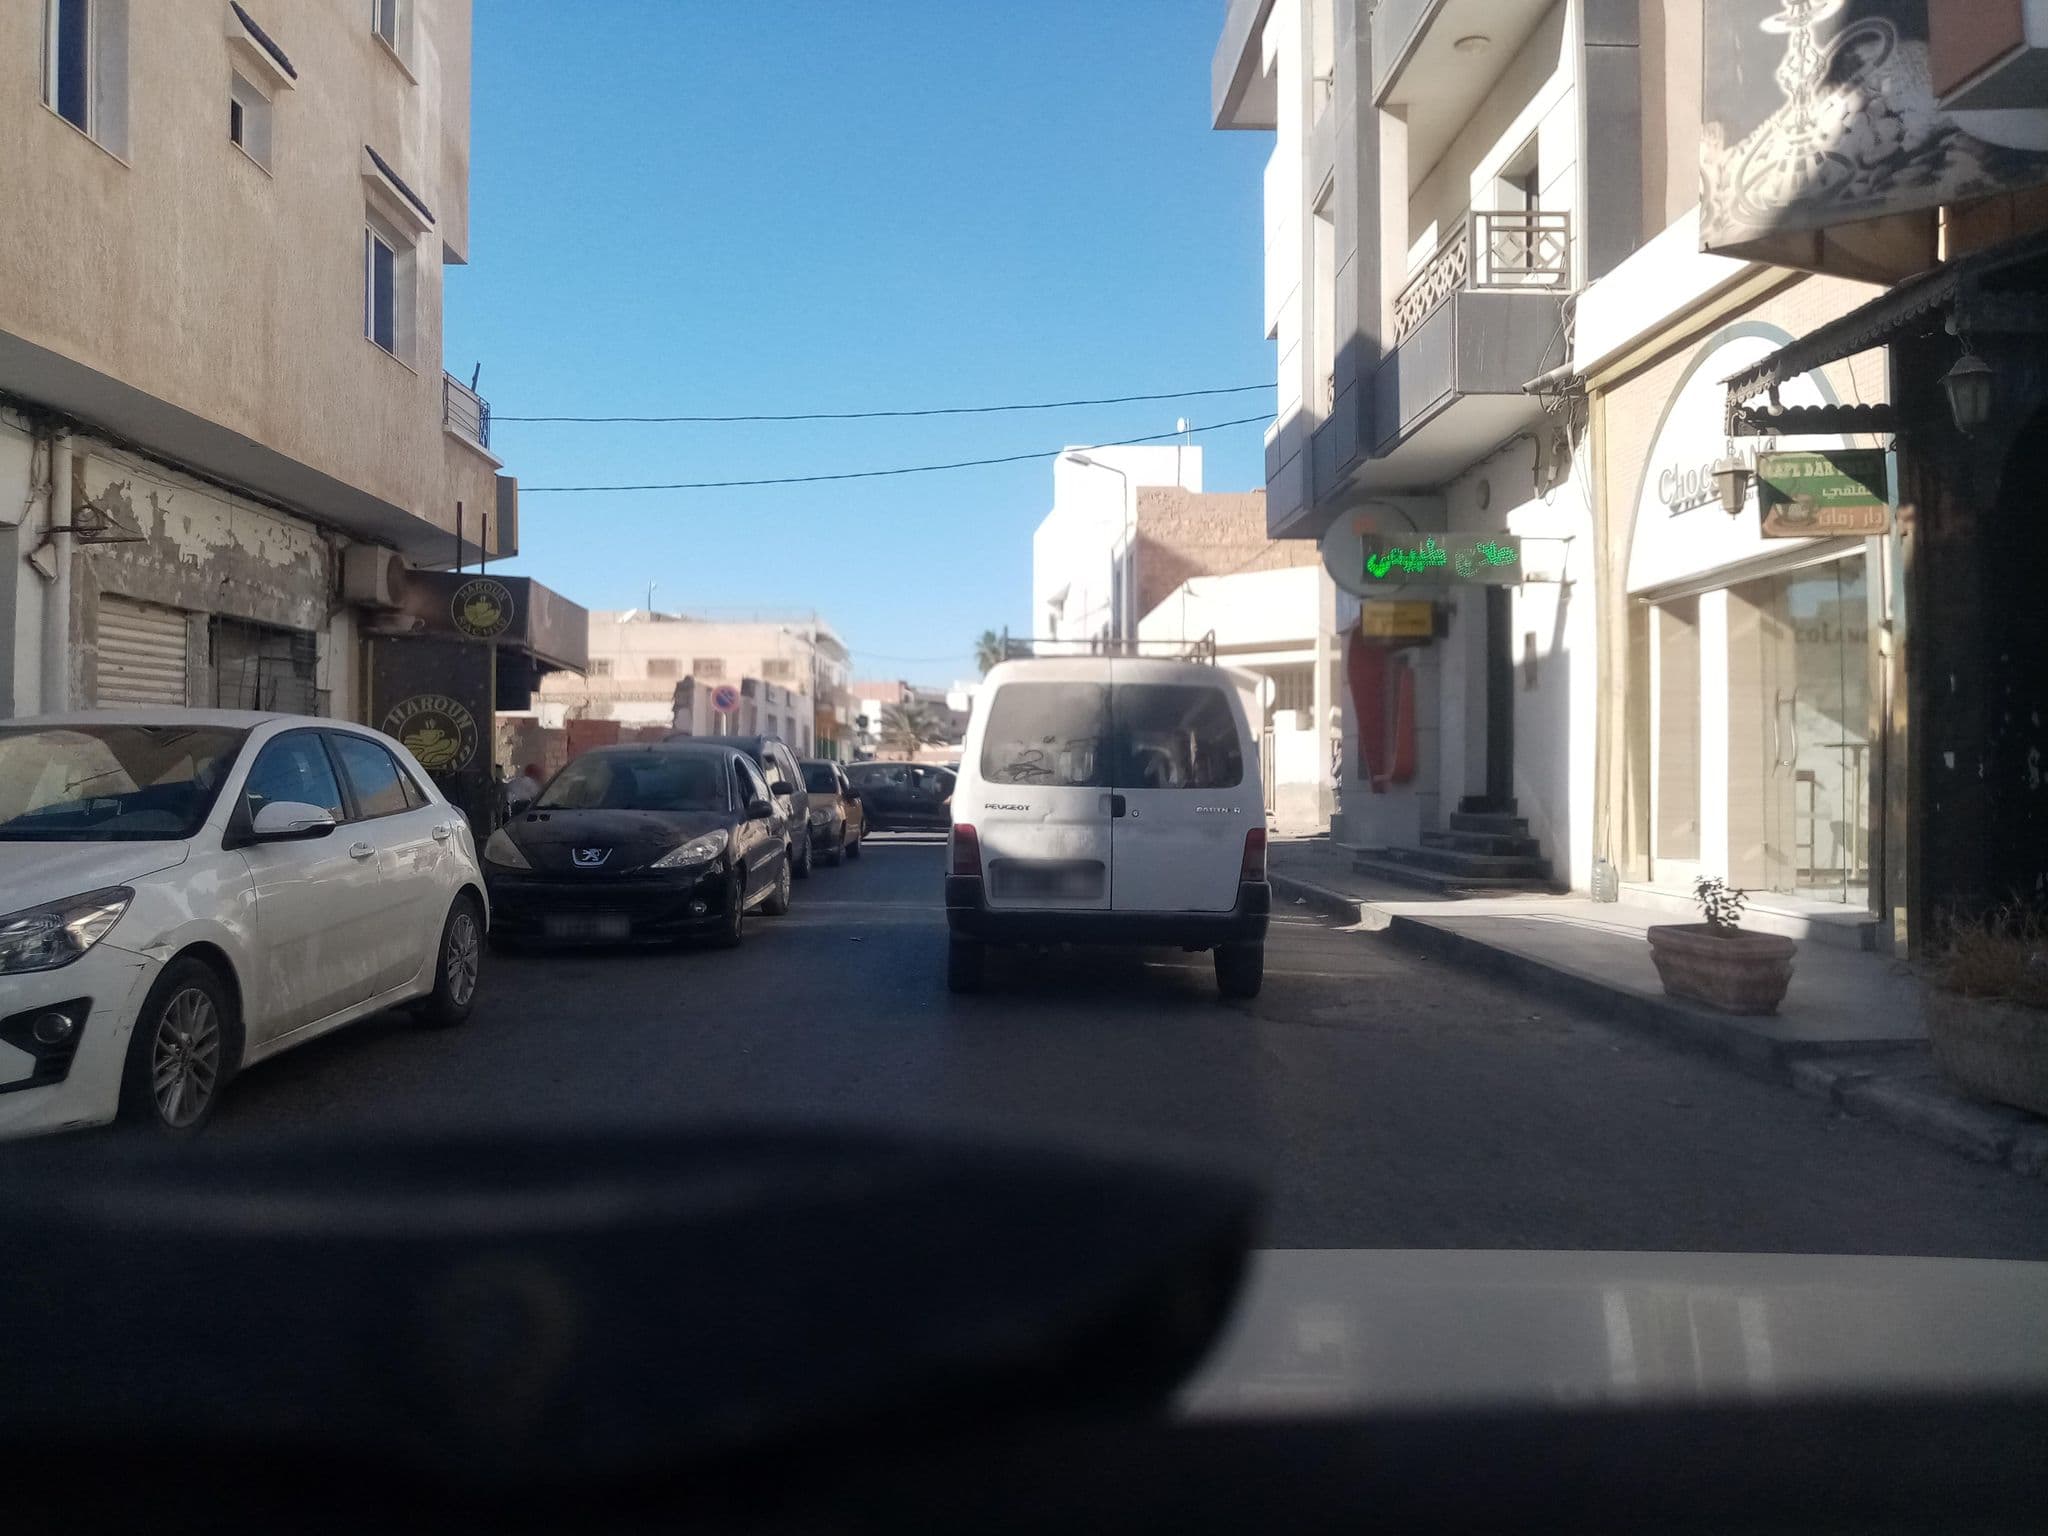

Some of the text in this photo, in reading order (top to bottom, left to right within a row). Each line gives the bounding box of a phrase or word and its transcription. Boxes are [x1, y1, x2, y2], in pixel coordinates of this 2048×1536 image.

[1864, 505, 1883, 528] دار
[387, 697, 473, 729] HAROUN
[984, 802, 1031, 812] PEUGEOT
[1195, 805, 1241, 814] PARTNR
